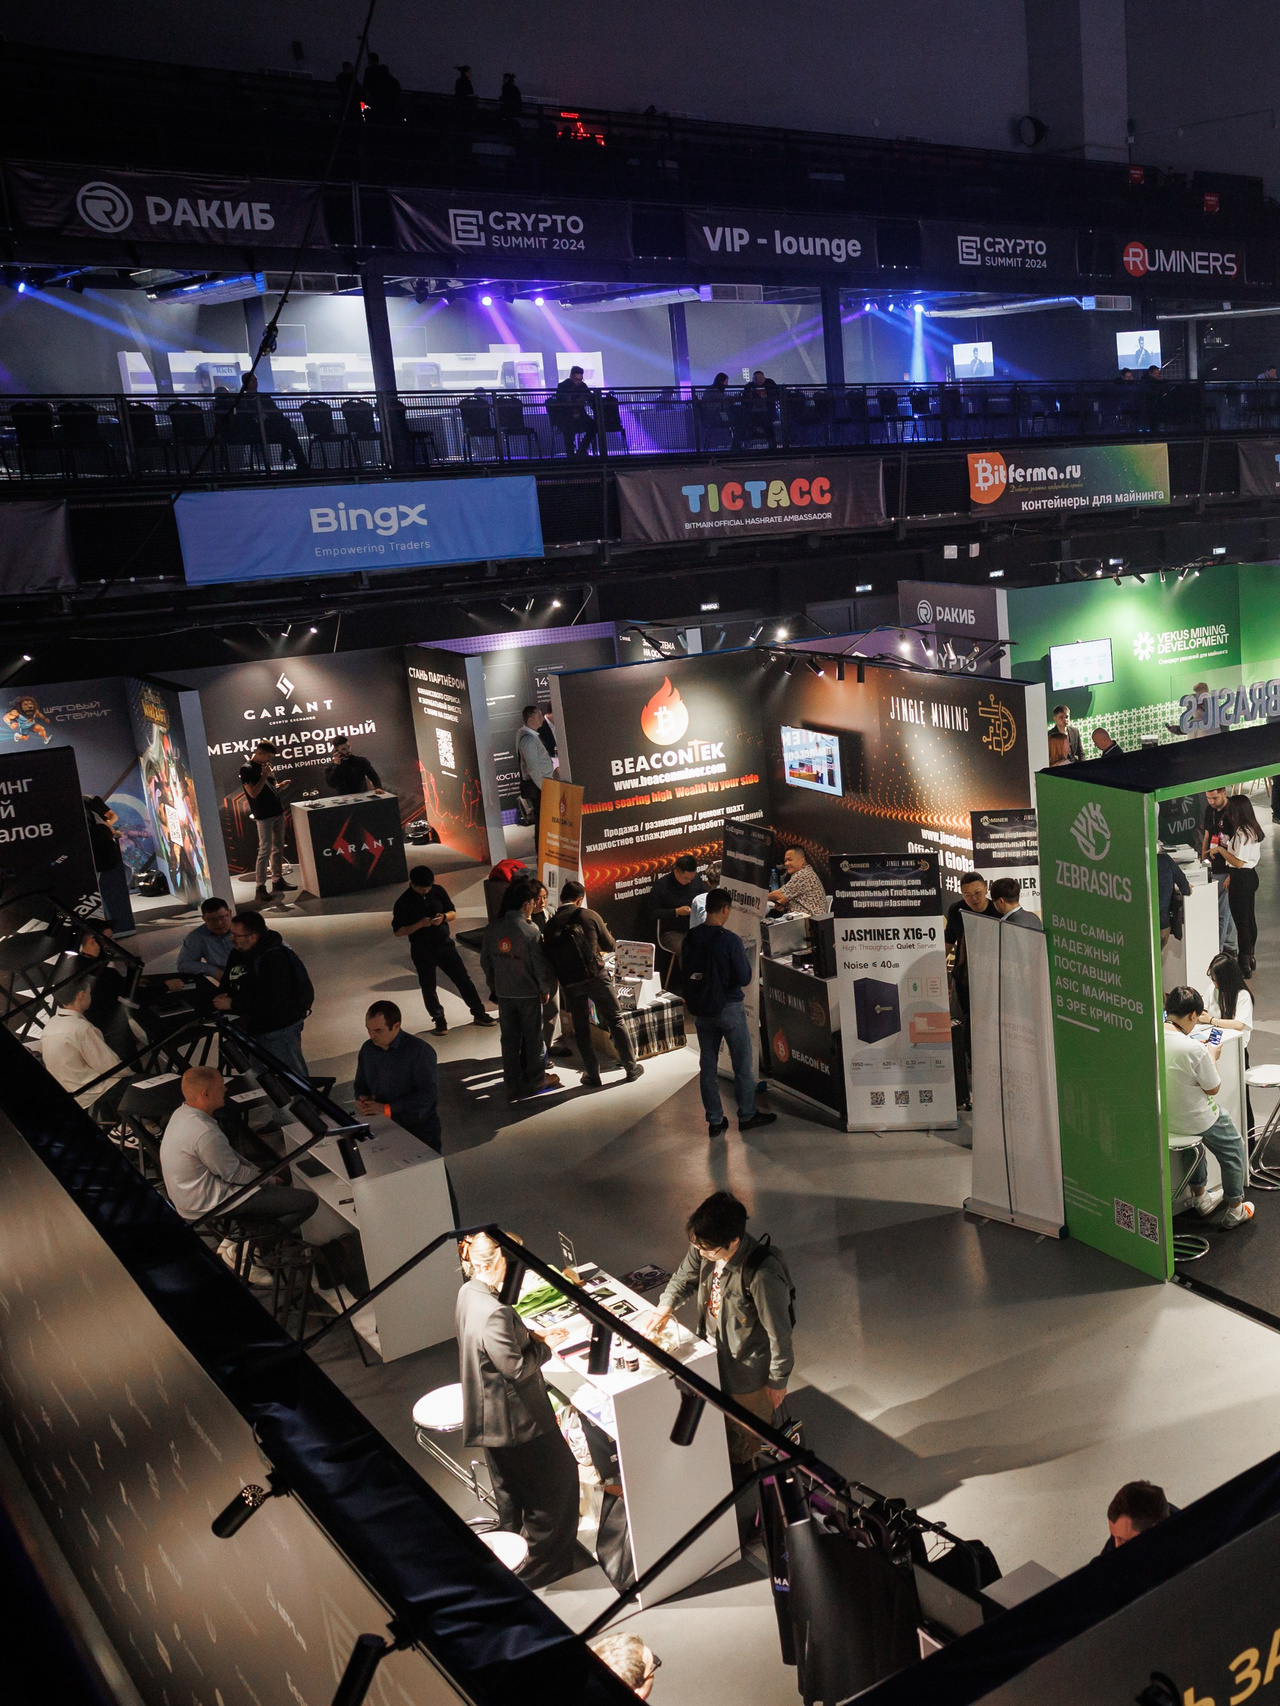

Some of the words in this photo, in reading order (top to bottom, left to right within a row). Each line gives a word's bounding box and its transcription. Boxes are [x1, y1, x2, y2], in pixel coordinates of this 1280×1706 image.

[146, 195, 274, 231] РАКИБ
[488, 211, 584, 235] CRYPTO
[491, 235, 547, 250] SUMMIT
[552, 238, 585, 251] 2024
[703, 226, 749, 252] VIP
[774, 229, 862, 263] lounge
[983, 236, 1048, 257] CRYPTO
[985, 256, 1022, 269] SUMMIT
[1024, 258, 1048, 269] 2024
[1124, 244, 1238, 276] RUMINERS
[681, 476, 832, 513] TICTACC
[1021, 496, 1090, 511] контейнеры
[1092, 494, 1112, 507] для
[1114, 489, 1164, 503] майнинга
[685, 521, 714, 530] BITMAIN
[714, 518, 744, 527] OFFICIAL
[745, 516, 783, 526] HASHRATE
[783, 512, 832, 523] AMBASSADOR
[315, 544, 385, 557] Empowering
[389, 540, 431, 552] Traders
[936, 606, 976, 625] РАКИБ
[1157, 628, 1190, 644] VEKUS
[1190, 624, 1226, 639] MINING
[1157, 633, 1230, 655] DEVELOPMENT
[409, 667, 428, 681] СТАНЬ
[428, 671, 466, 690] ПАРТНЁРОМ
[243, 699, 333, 720] GARANT
[890, 696, 926, 725] JINGLE
[931, 702, 969, 732] MINING
[611, 739, 725, 776] BEACONTEK
[581, 799, 613, 815] Mining
[615, 793, 650, 809] soaring
[651, 790, 673, 803] high
[675, 782, 707, 799] Wealth
[708, 779, 719, 792] by
[719, 777, 740, 790] your
[740, 773, 760, 786] side
[604, 826, 639, 838] Продажа
[645, 814, 692, 831] размещение
[698, 808, 725, 821] ремонт
[726, 803, 745, 814] шахт
[1167, 817, 1196, 835] VMD
[323, 837, 394, 857] GARANT
[585, 836, 634, 853] жидкостное
[635, 828, 682, 843] охлаждение
[976, 840, 1026, 850] Официальный
[615, 879, 634, 889] Miner
[635, 875, 652, 886] Sales
[850, 879, 921, 887] www.jinglemining.com
[1055, 859, 1132, 903] ZEBRASICS
[614, 889, 634, 900] Liquid
[835, 889, 889, 899] Официальный
[890, 887, 937, 897] Глобальный
[853, 899, 883, 908] Партнер
[884, 899, 921, 907] #Jasminer
[841, 928, 900, 942] JASMINER
[904, 927, 936, 941] X16-Q
[1052, 914, 1077, 933] ВАШ
[1080, 922, 1124, 947] САМЫЙ
[1053, 935, 1120, 966] НАДЕЖНЫЙ
[843, 961, 868, 970] Noise
[880, 960, 900, 968] 40dB
[1054, 955, 1122, 987] ПОСТАВЩИК
[1055, 976, 1079, 993] ASIC
[1082, 984, 1144, 1015] МАЙНЕРОВ
[1066, 999, 1087, 1016] ЭРЕ
[1090, 1007, 1133, 1031] КРИПТО
